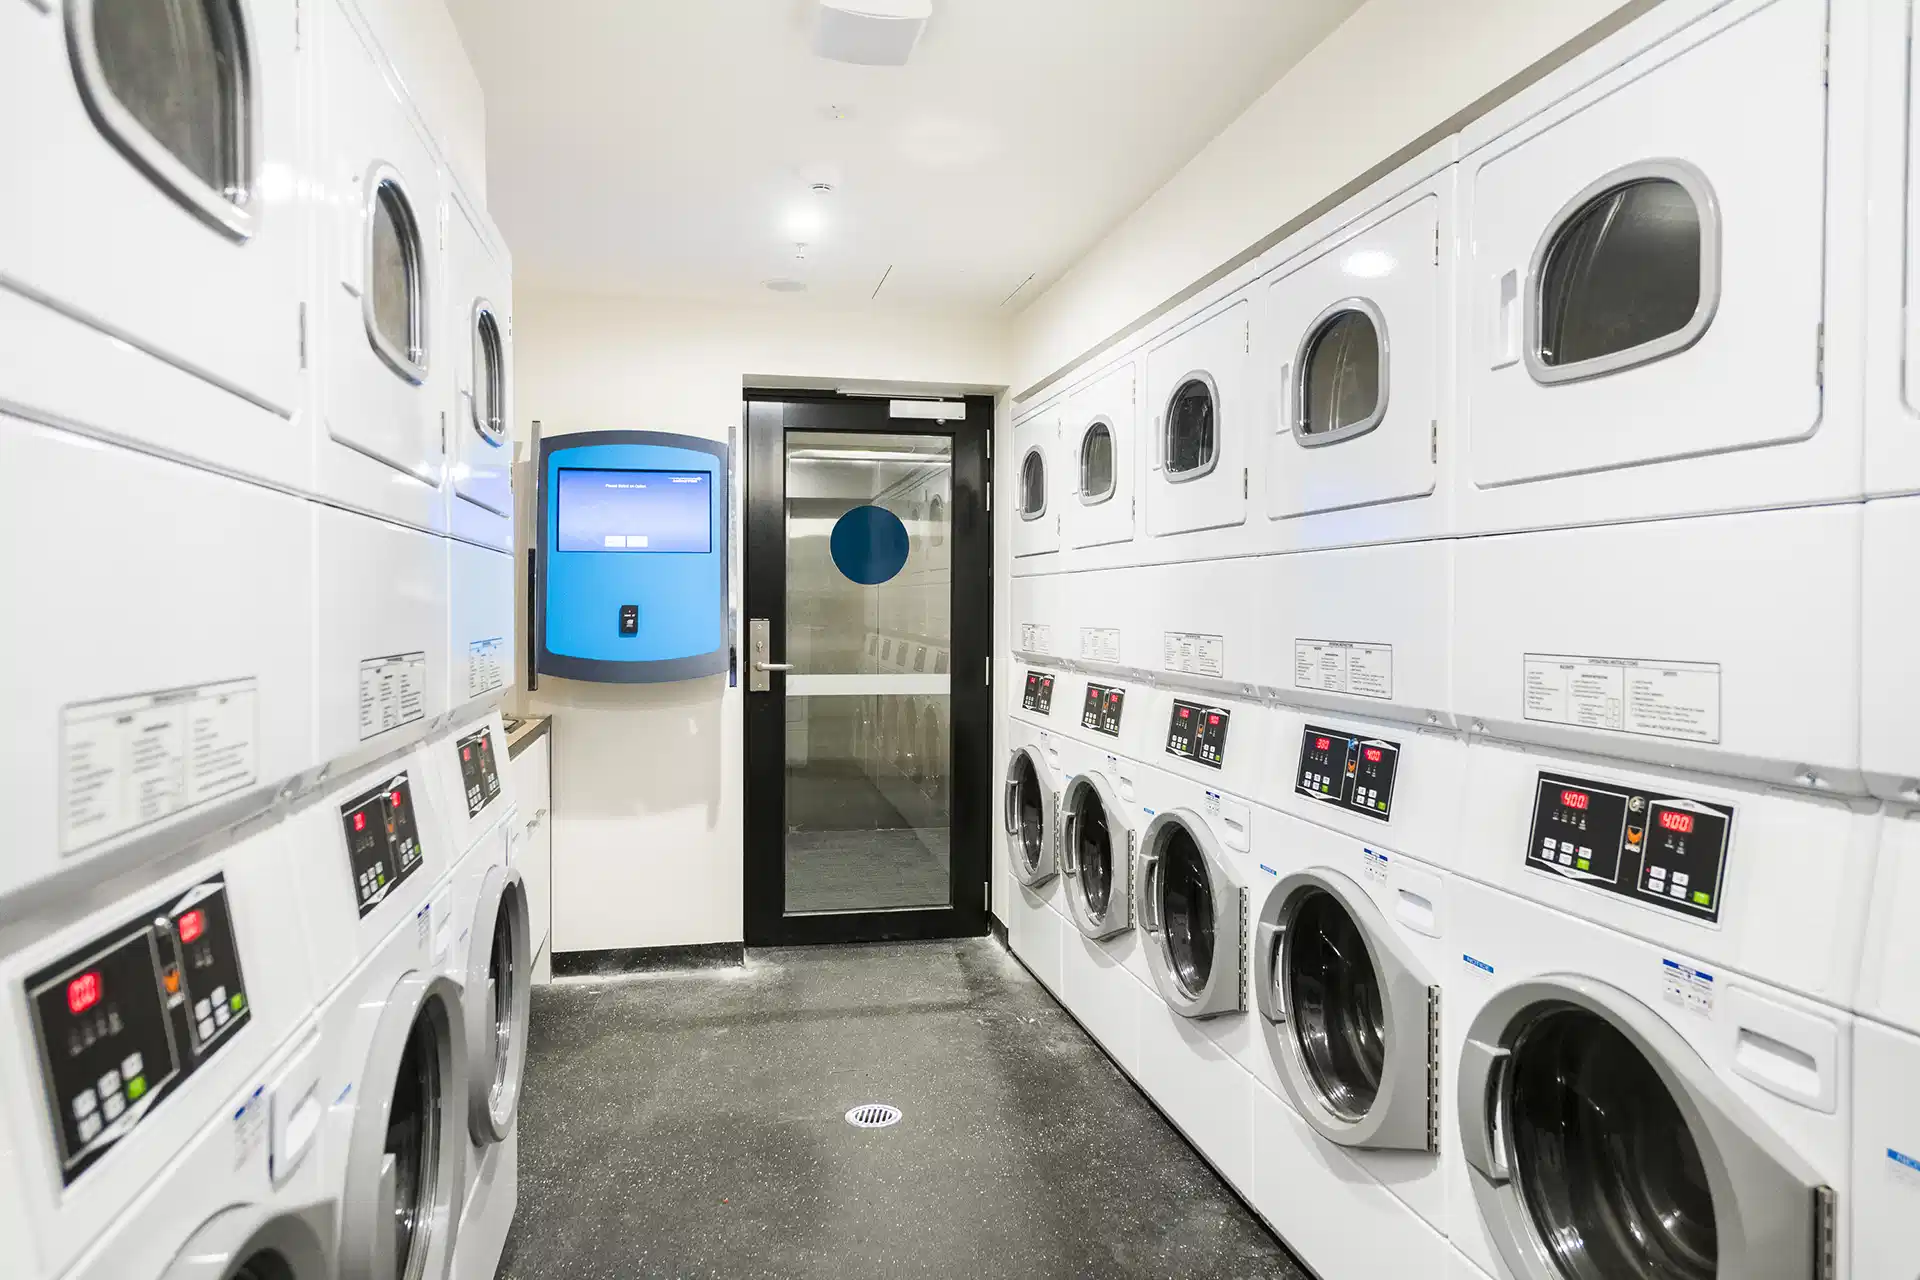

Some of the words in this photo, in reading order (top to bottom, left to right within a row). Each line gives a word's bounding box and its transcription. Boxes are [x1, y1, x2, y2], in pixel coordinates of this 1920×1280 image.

[1564, 791, 1585, 808] 400
[1663, 812, 1689, 831] 400
[1467, 956, 1490, 971] NOTICE
